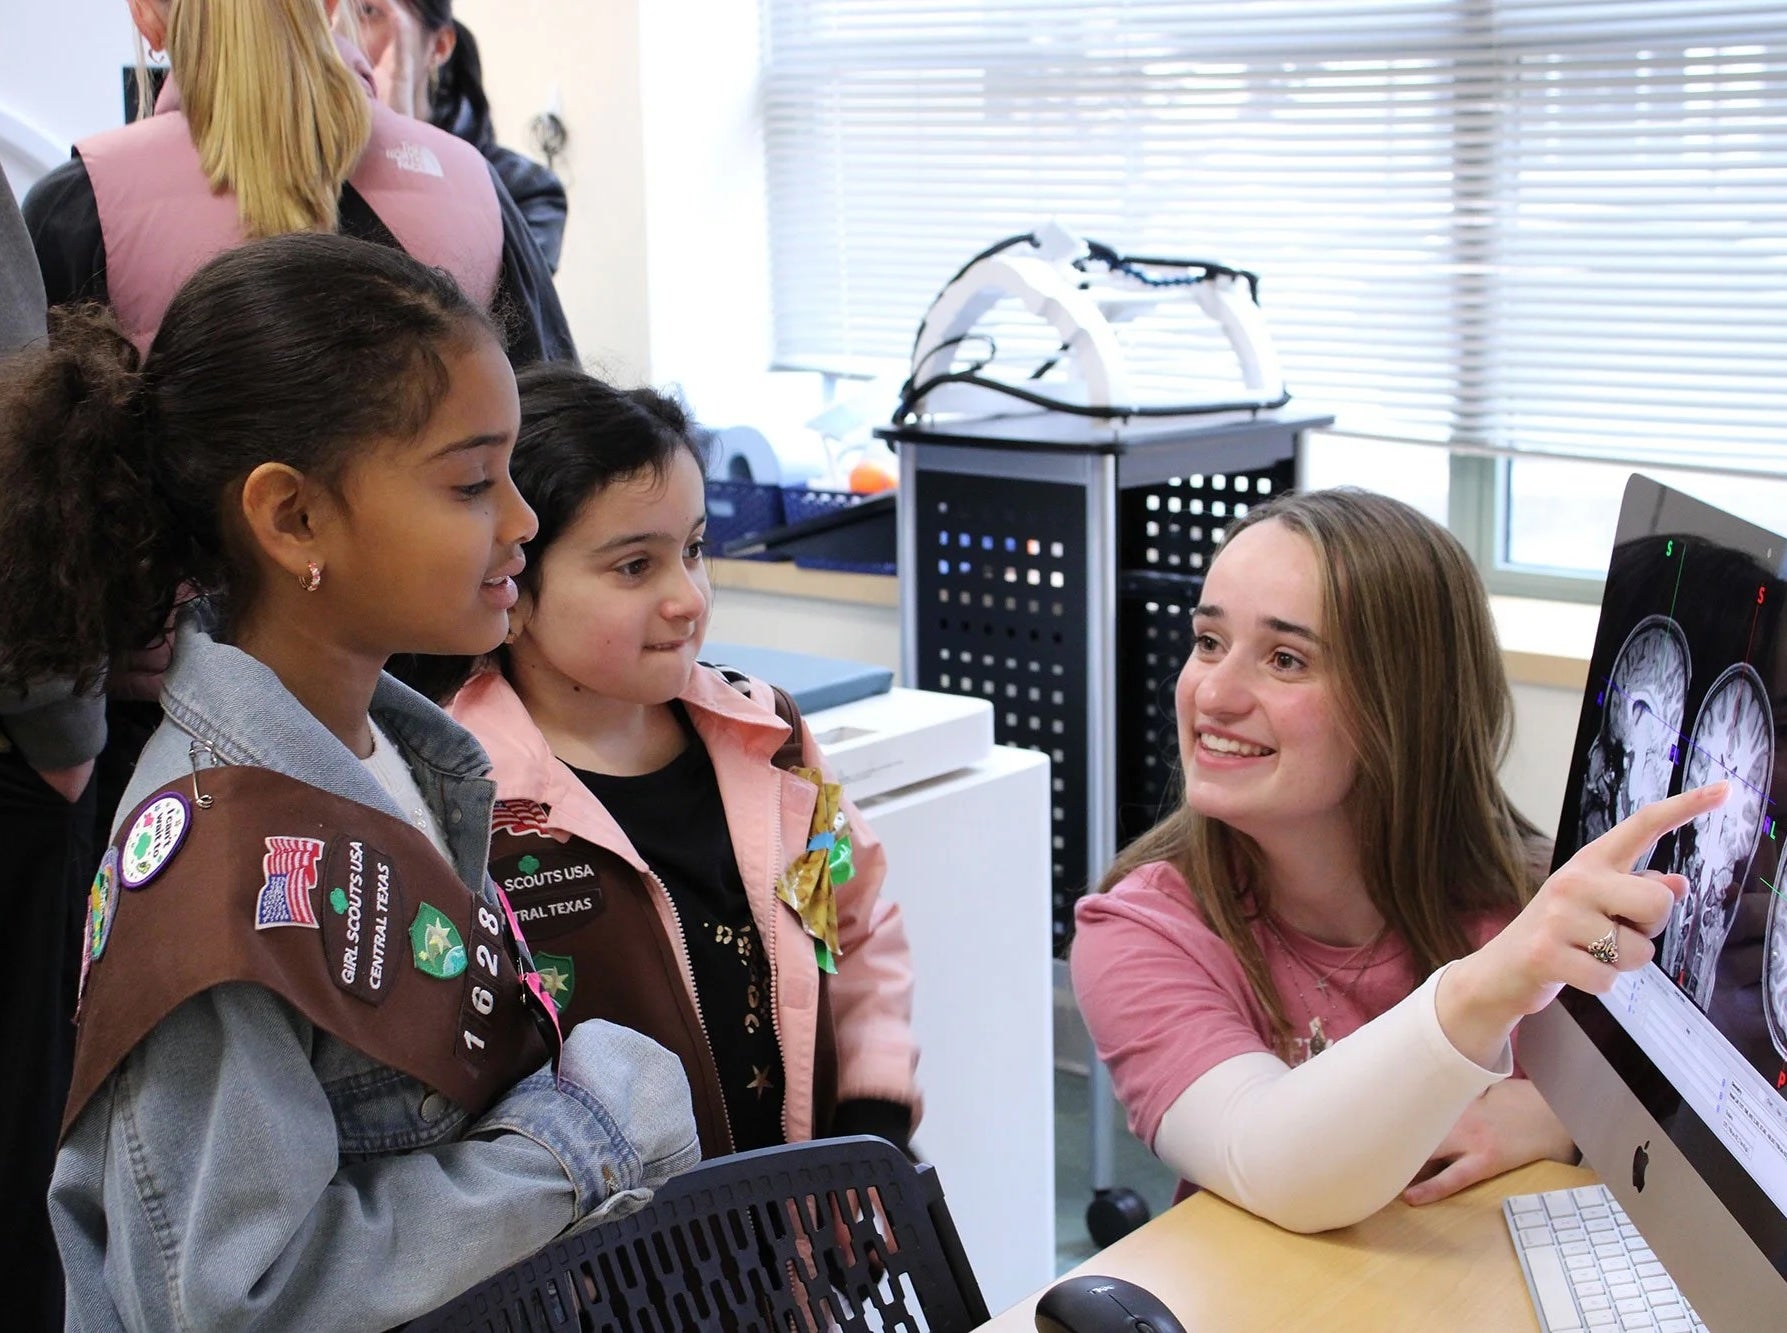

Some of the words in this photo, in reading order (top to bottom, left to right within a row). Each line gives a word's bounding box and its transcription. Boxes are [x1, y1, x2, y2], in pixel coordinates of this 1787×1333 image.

[1665, 540, 1673, 557] S
[1757, 586, 1766, 604] S
[154, 812, 164, 842] wait
[163, 815, 173, 848] can't
[153, 842, 162, 858] to
[350, 842, 364, 873] USA
[376, 862, 390, 913] TEXAS
[504, 869, 563, 892] SCOUTS
[564, 864, 595, 880] USA
[346, 872, 364, 944] SCOUTS
[512, 906, 548, 922] TRAL
[548, 897, 593, 917] TEXAS
[341, 945, 359, 984] GIRL
[369, 916, 388, 990] CENTRAL
[1777, 1070, 1786, 1089] P
